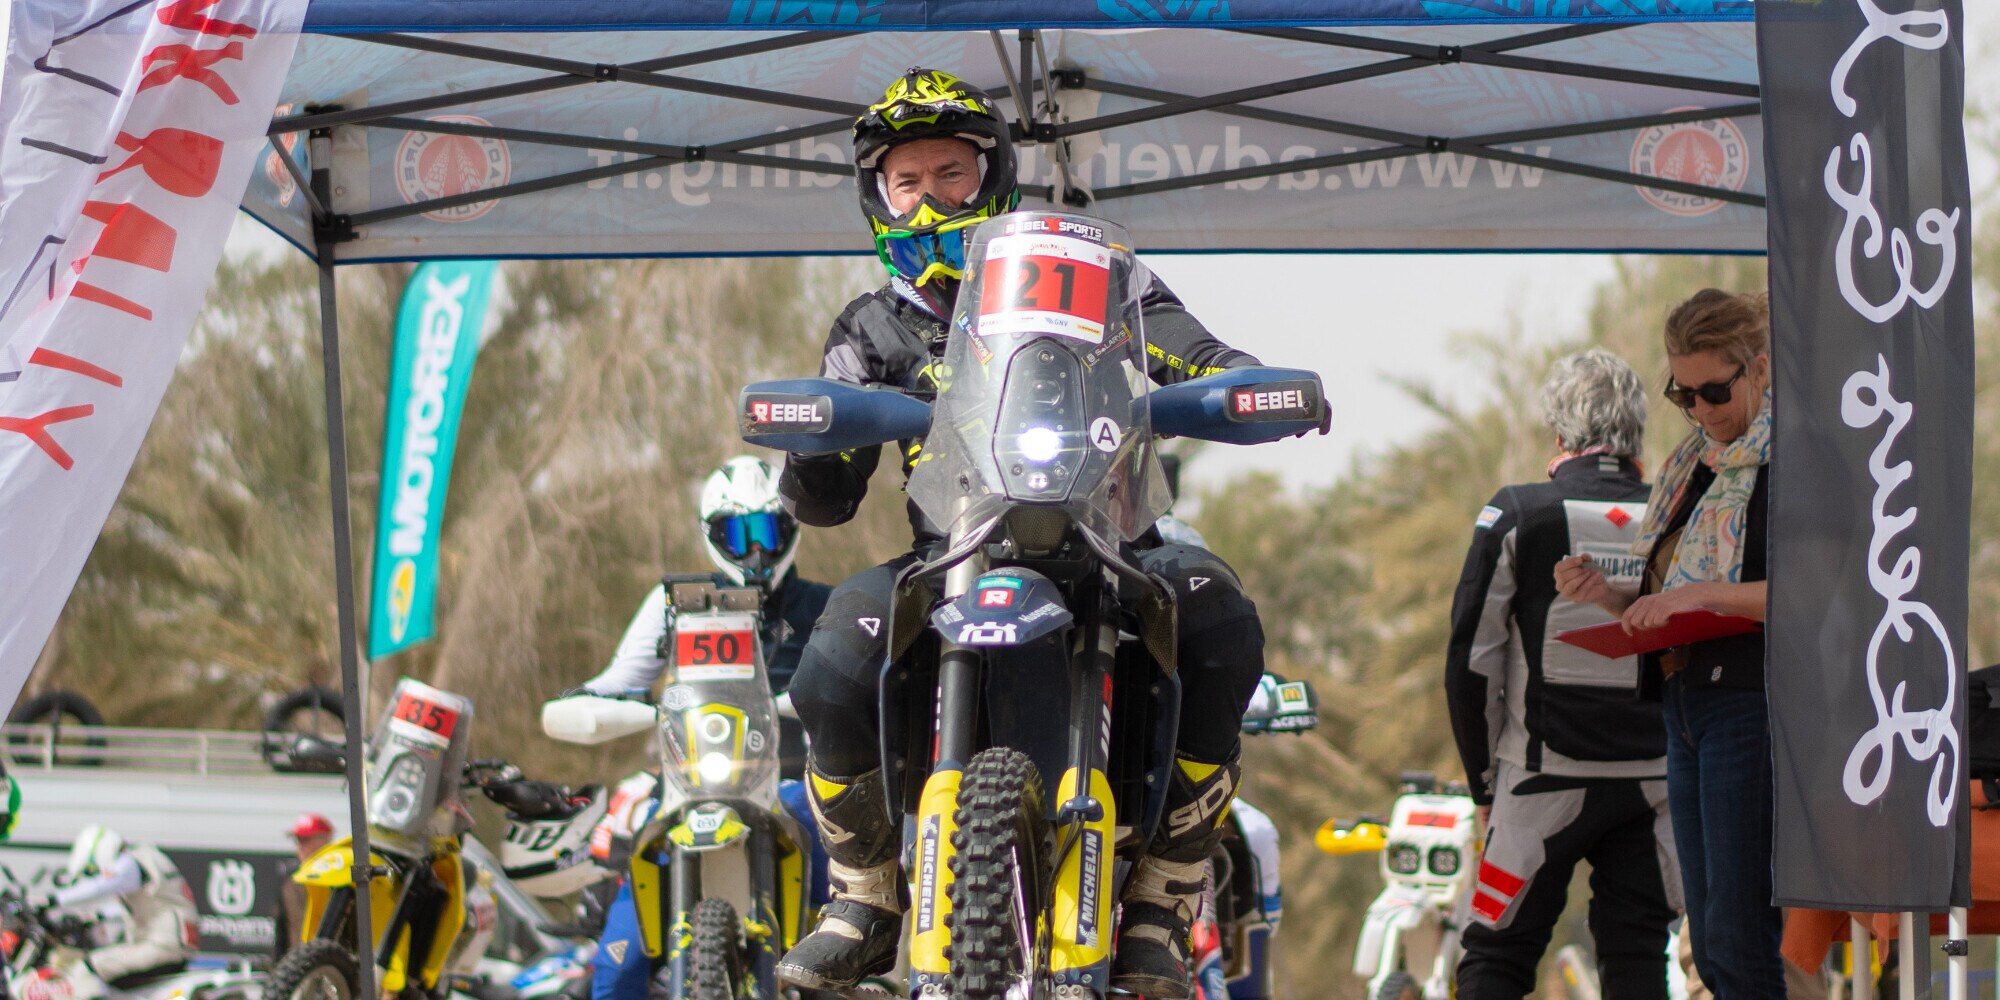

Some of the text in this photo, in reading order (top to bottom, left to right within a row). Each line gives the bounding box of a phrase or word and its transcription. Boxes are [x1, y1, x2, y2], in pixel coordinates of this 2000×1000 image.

[1013, 260, 1076, 312] 21
[387, 272, 471, 557] MOTOREX
[753, 402, 823, 423] REBEL
[1235, 389, 1304, 415] REBEL
[1097, 422, 1116, 446] A
[984, 590, 1008, 606] R
[692, 634, 740, 665] 50
[405, 698, 446, 731] 35
[751, 733, 762, 748] B
[918, 837, 936, 929] MICHELIN
[1081, 831, 1098, 923] MICHELIN
